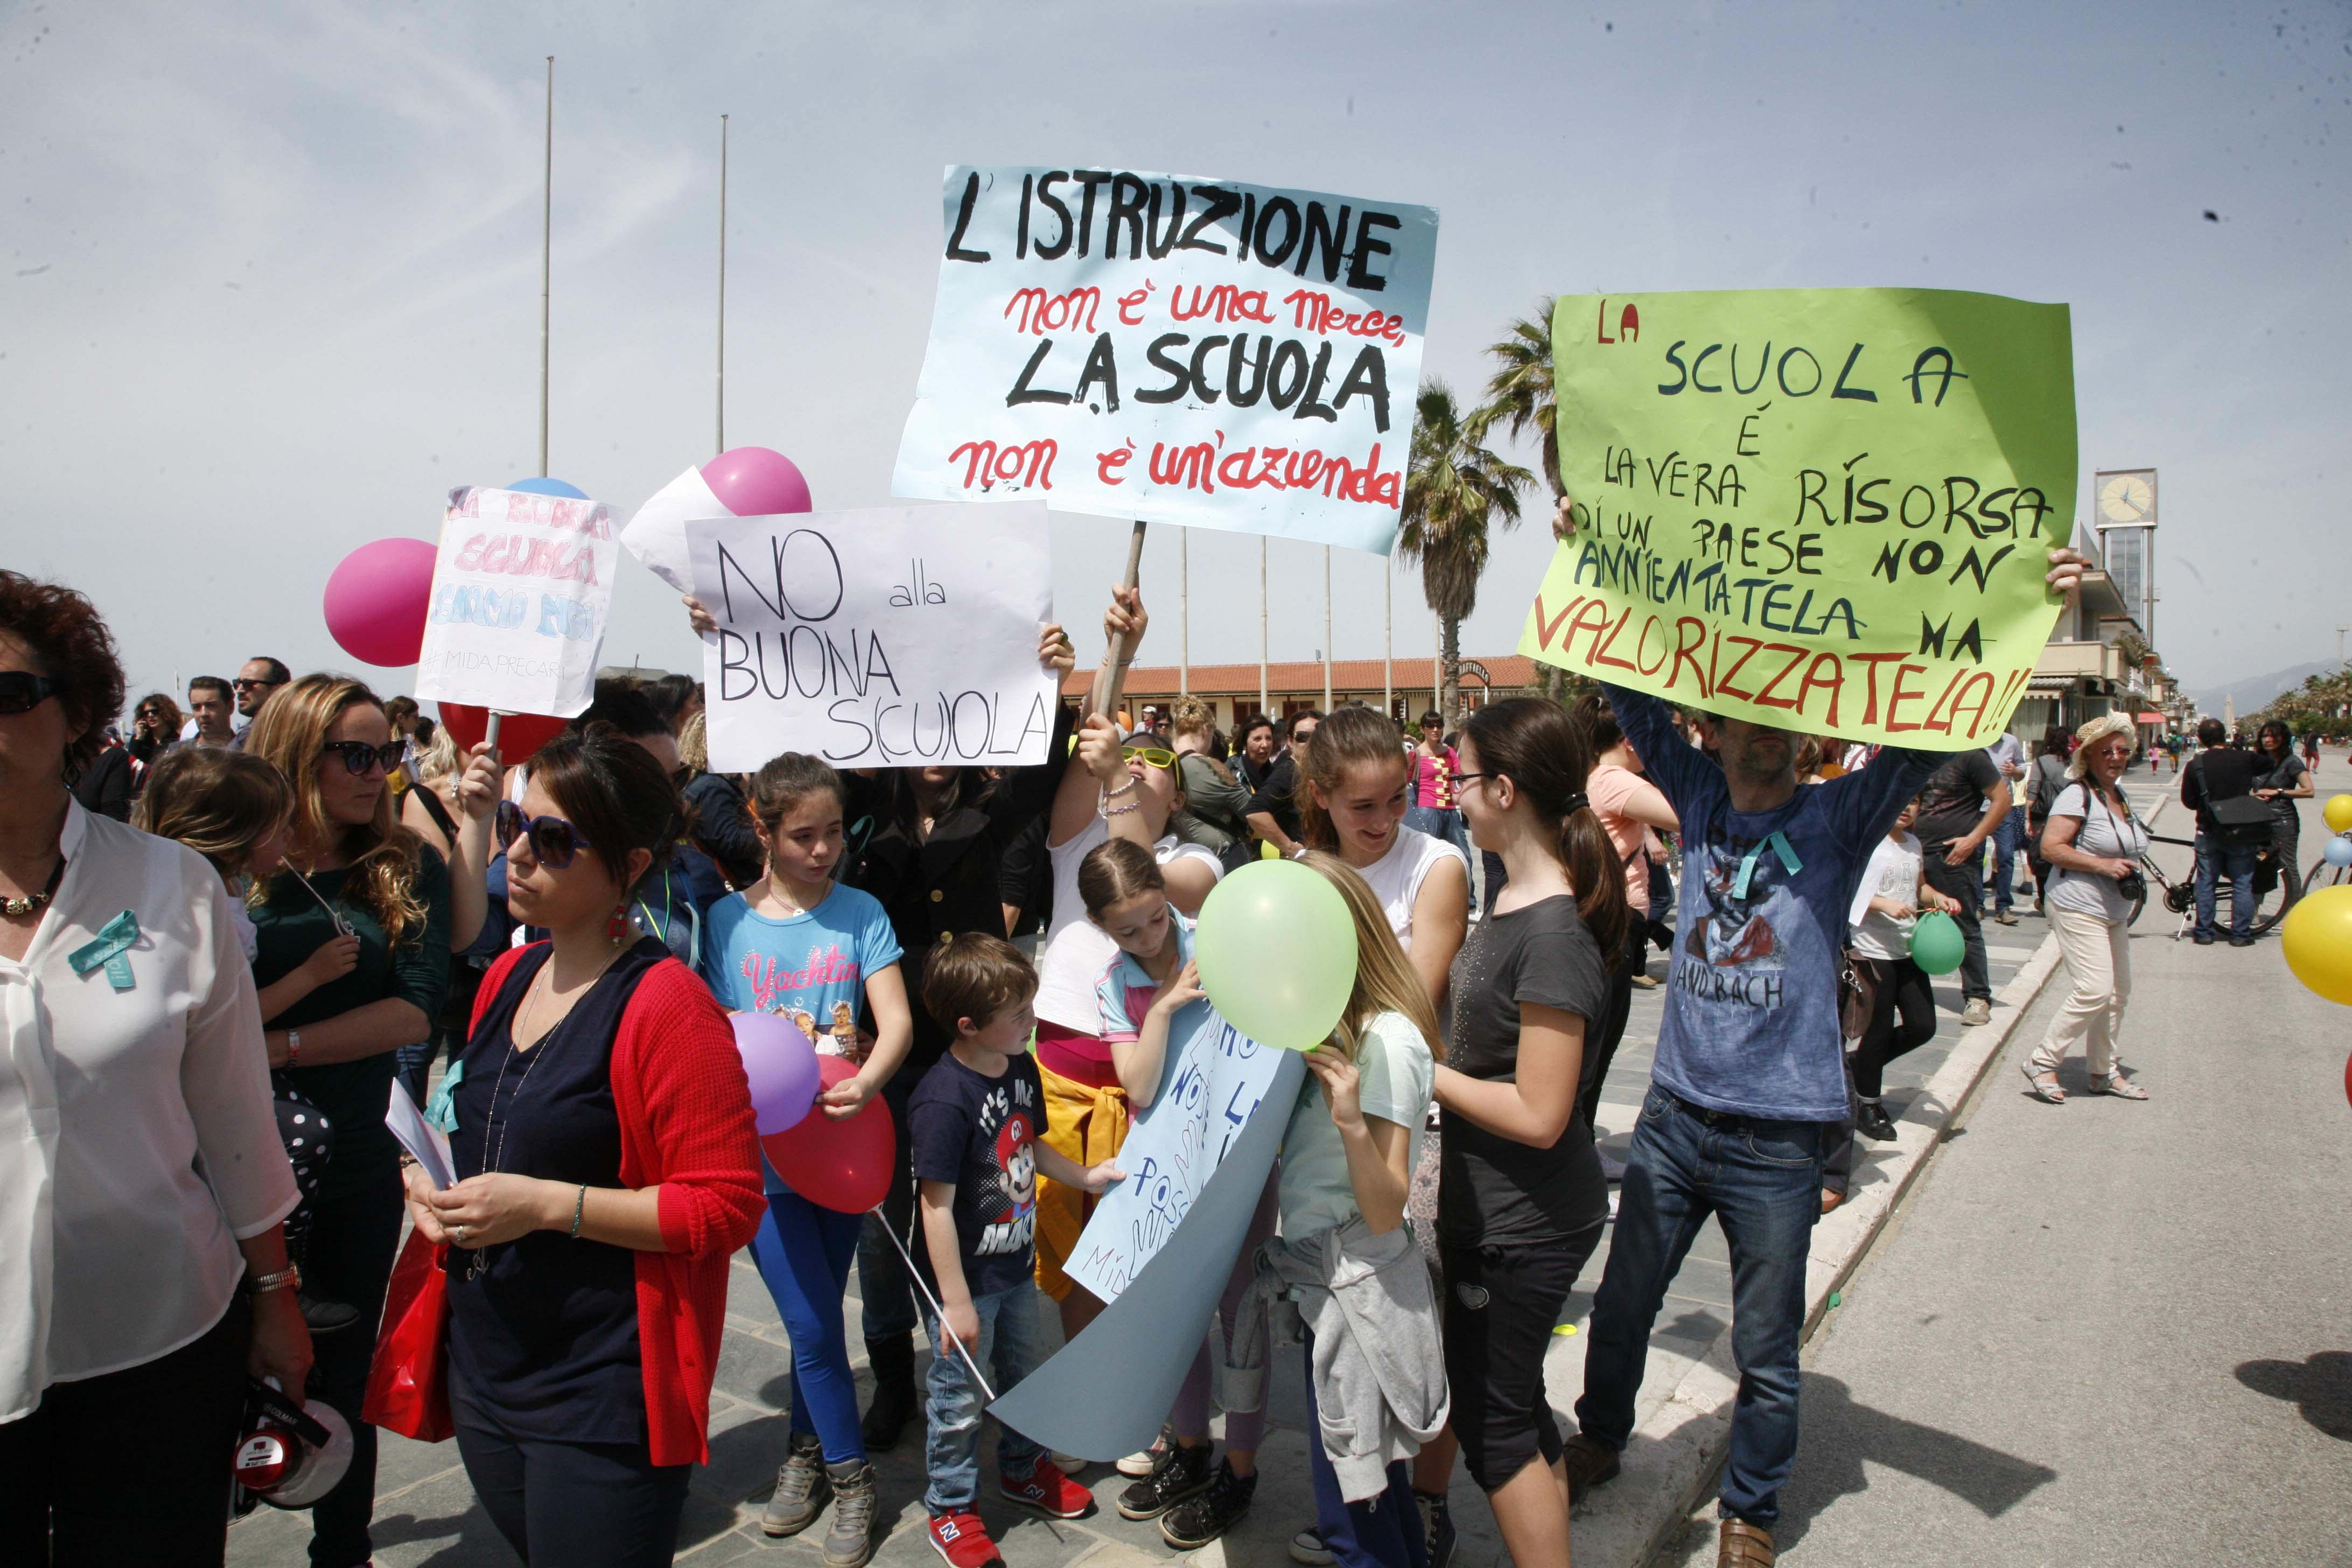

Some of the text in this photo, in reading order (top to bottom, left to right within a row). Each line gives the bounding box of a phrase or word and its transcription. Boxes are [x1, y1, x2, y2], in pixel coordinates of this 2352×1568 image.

[1016, 169, 1402, 291] ISTRUZIONE
[1004, 285, 1101, 336] non
[1117, 278, 1157, 325] è
[1170, 283, 1277, 324] una
[1597, 298, 1640, 345] LA
[1006, 331, 1392, 434] LA SCUOLA
[1658, 340, 1968, 407] SCUOLA
[949, 438, 1058, 489] non
[1096, 436, 1137, 486] è
[1604, 445, 1636, 485] LA
[1647, 451, 1747, 507] VERA
[506, 494, 612, 541] BUONA
[453, 533, 599, 587] SCUOLA
[717, 529, 946, 624] NO alla
[1618, 514, 1653, 551] UN
[1692, 517, 1824, 575] PAESE
[1871, 538, 2016, 594] NON
[431, 583, 596, 642] SIAMO NOI
[1918, 610, 1997, 665] MA
[719, 625, 901, 702] BUONA
[1458, 662, 1489, 682] RAFFAELLO
[1676, 960, 1783, 1008] AND BACH
[939, 1521, 961, 1543] N
